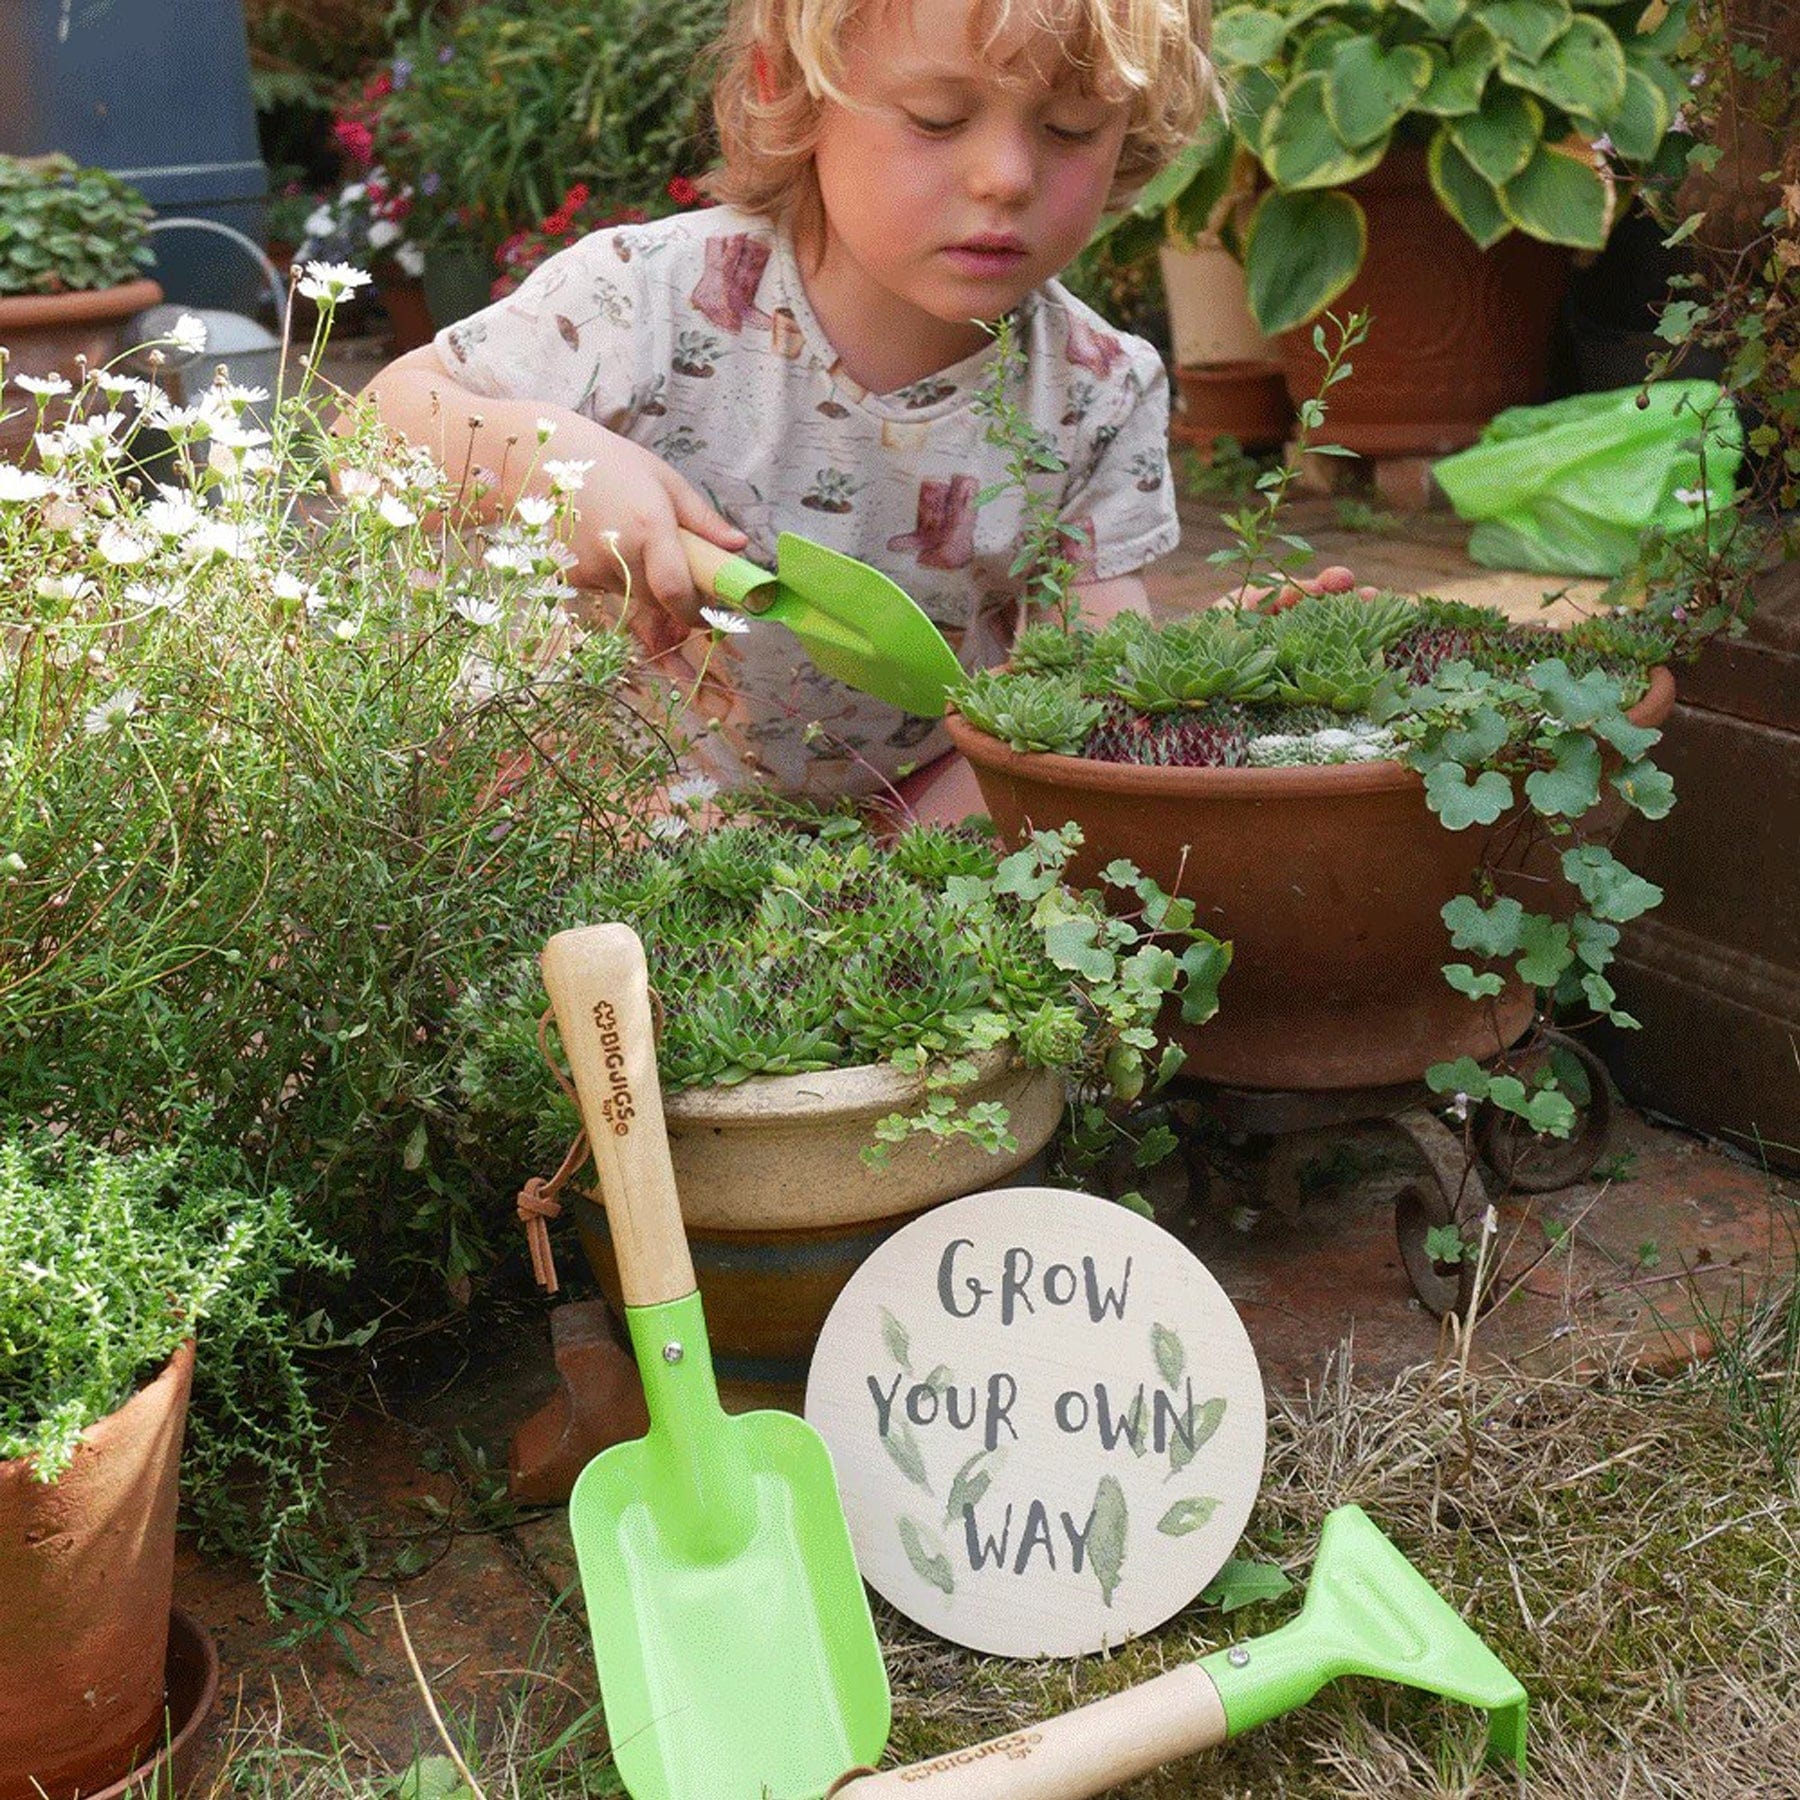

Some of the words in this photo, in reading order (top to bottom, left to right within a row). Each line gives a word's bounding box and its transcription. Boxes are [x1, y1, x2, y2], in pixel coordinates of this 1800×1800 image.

[600, 1031, 635, 1121] BIGJIGS
[937, 1238, 1133, 1326] GROW
[866, 1372, 1019, 1452] YOUR
[1054, 1376, 1198, 1454] OWN
[962, 1499, 1098, 1575] WAY
